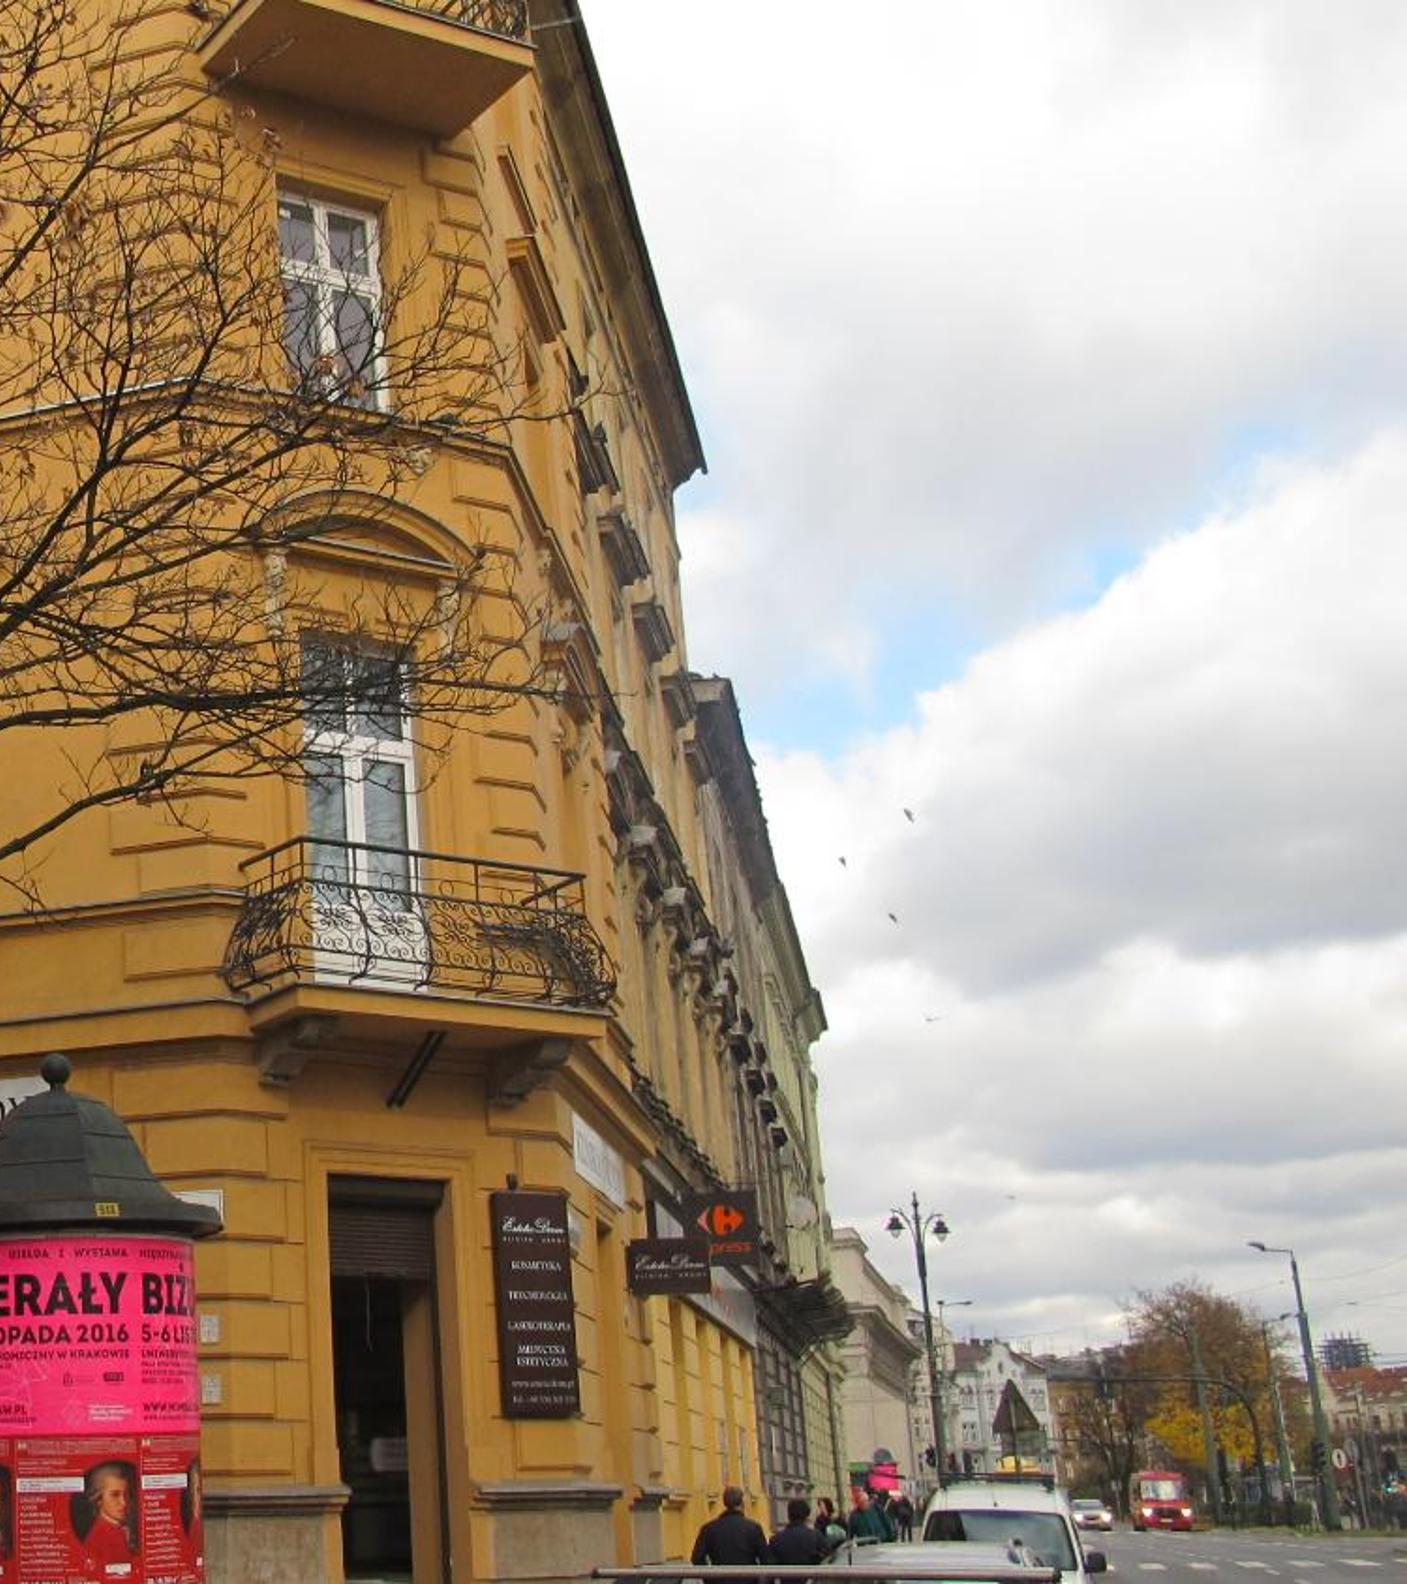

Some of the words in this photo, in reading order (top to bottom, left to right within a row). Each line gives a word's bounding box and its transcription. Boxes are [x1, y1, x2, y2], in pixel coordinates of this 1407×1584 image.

[141, 1262, 193, 1317] BIŻ
[77, 1323, 130, 1344] 2016
[142, 1324, 170, 1343] 5-6
[70, 1348, 130, 1360] KRAKOWIE
